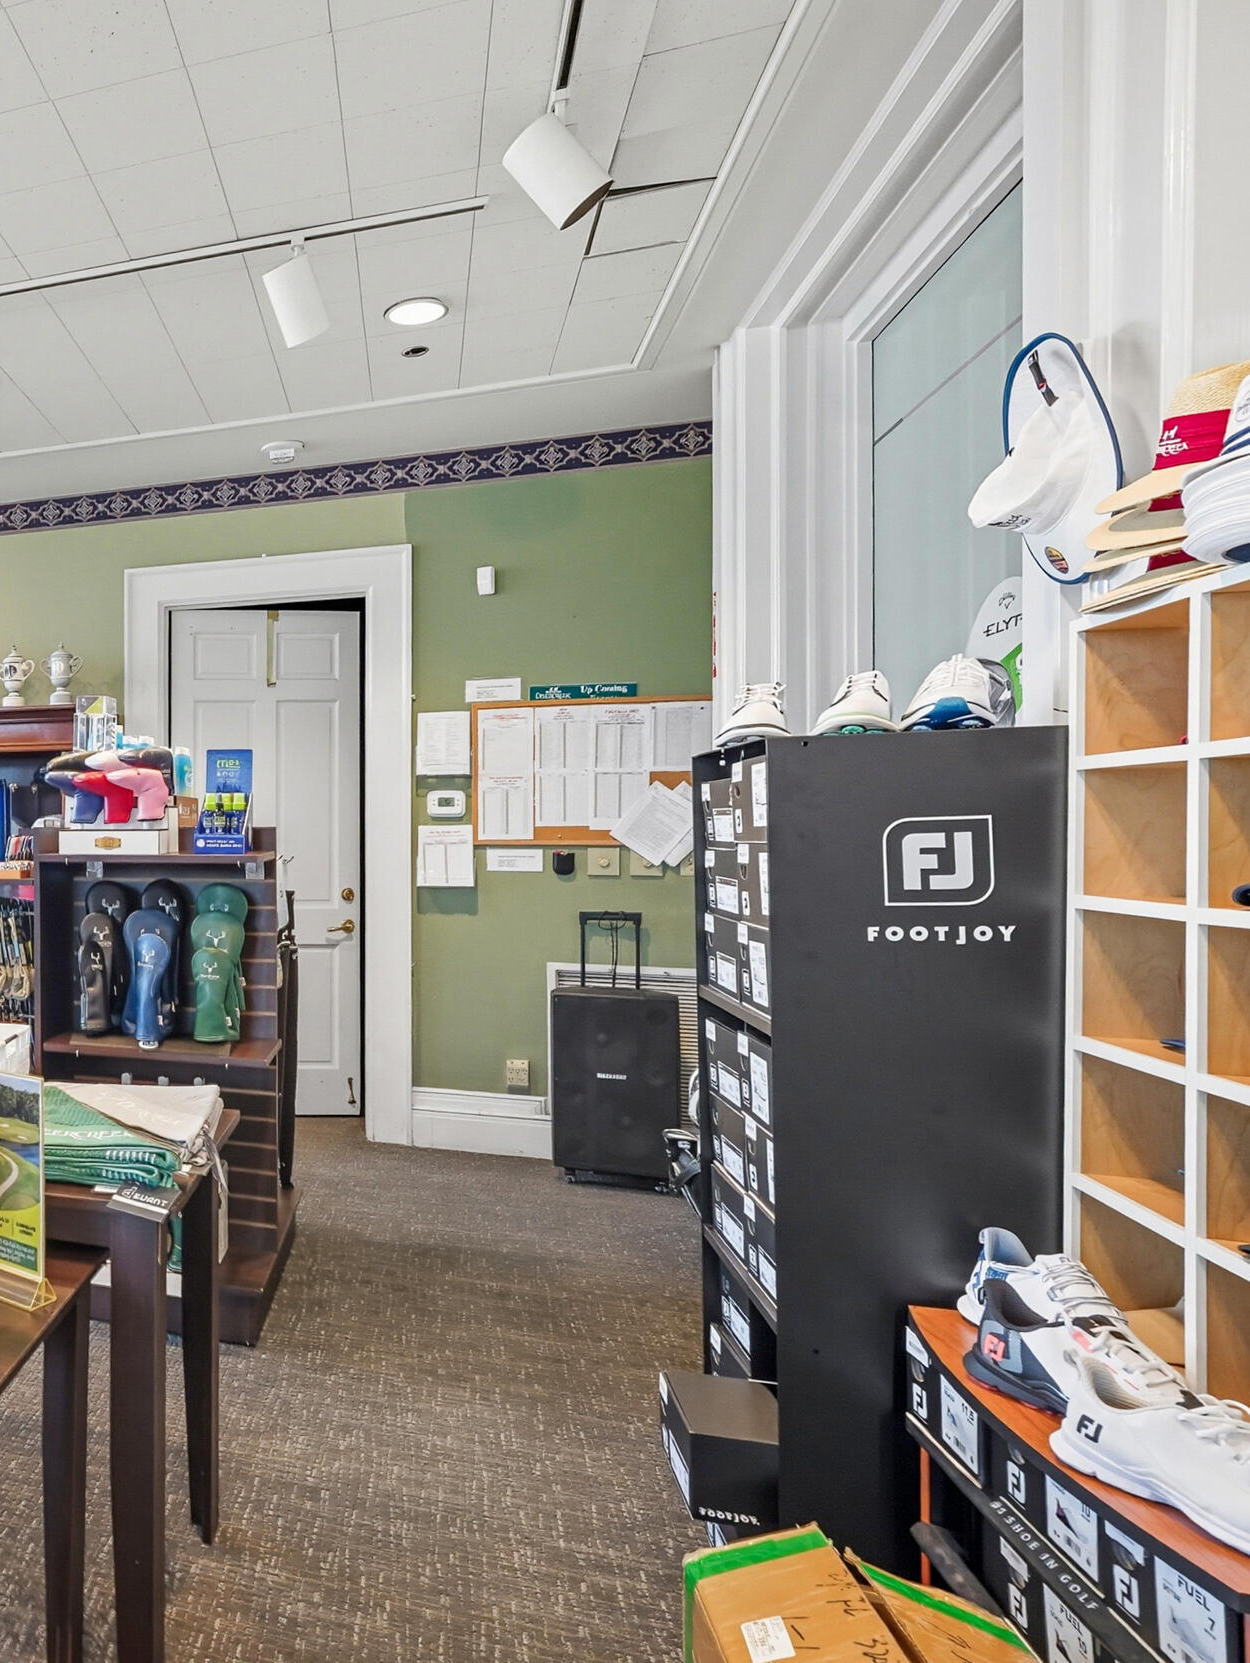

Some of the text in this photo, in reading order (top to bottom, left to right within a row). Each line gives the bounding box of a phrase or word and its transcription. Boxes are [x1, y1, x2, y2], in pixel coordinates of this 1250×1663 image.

[983, 613, 1022, 637] ELYT
[580, 684, 593, 694] Up
[902, 831, 975, 890] FJ
[867, 925, 1017, 945] FOOTJOY
[1077, 1414, 1103, 1443] FJ
[1003, 1513, 1041, 1551] SHOE
[1039, 1552, 1059, 1571] IN
[1060, 1573, 1100, 1611] GOLF
[1177, 1575, 1211, 1612] FUEL
